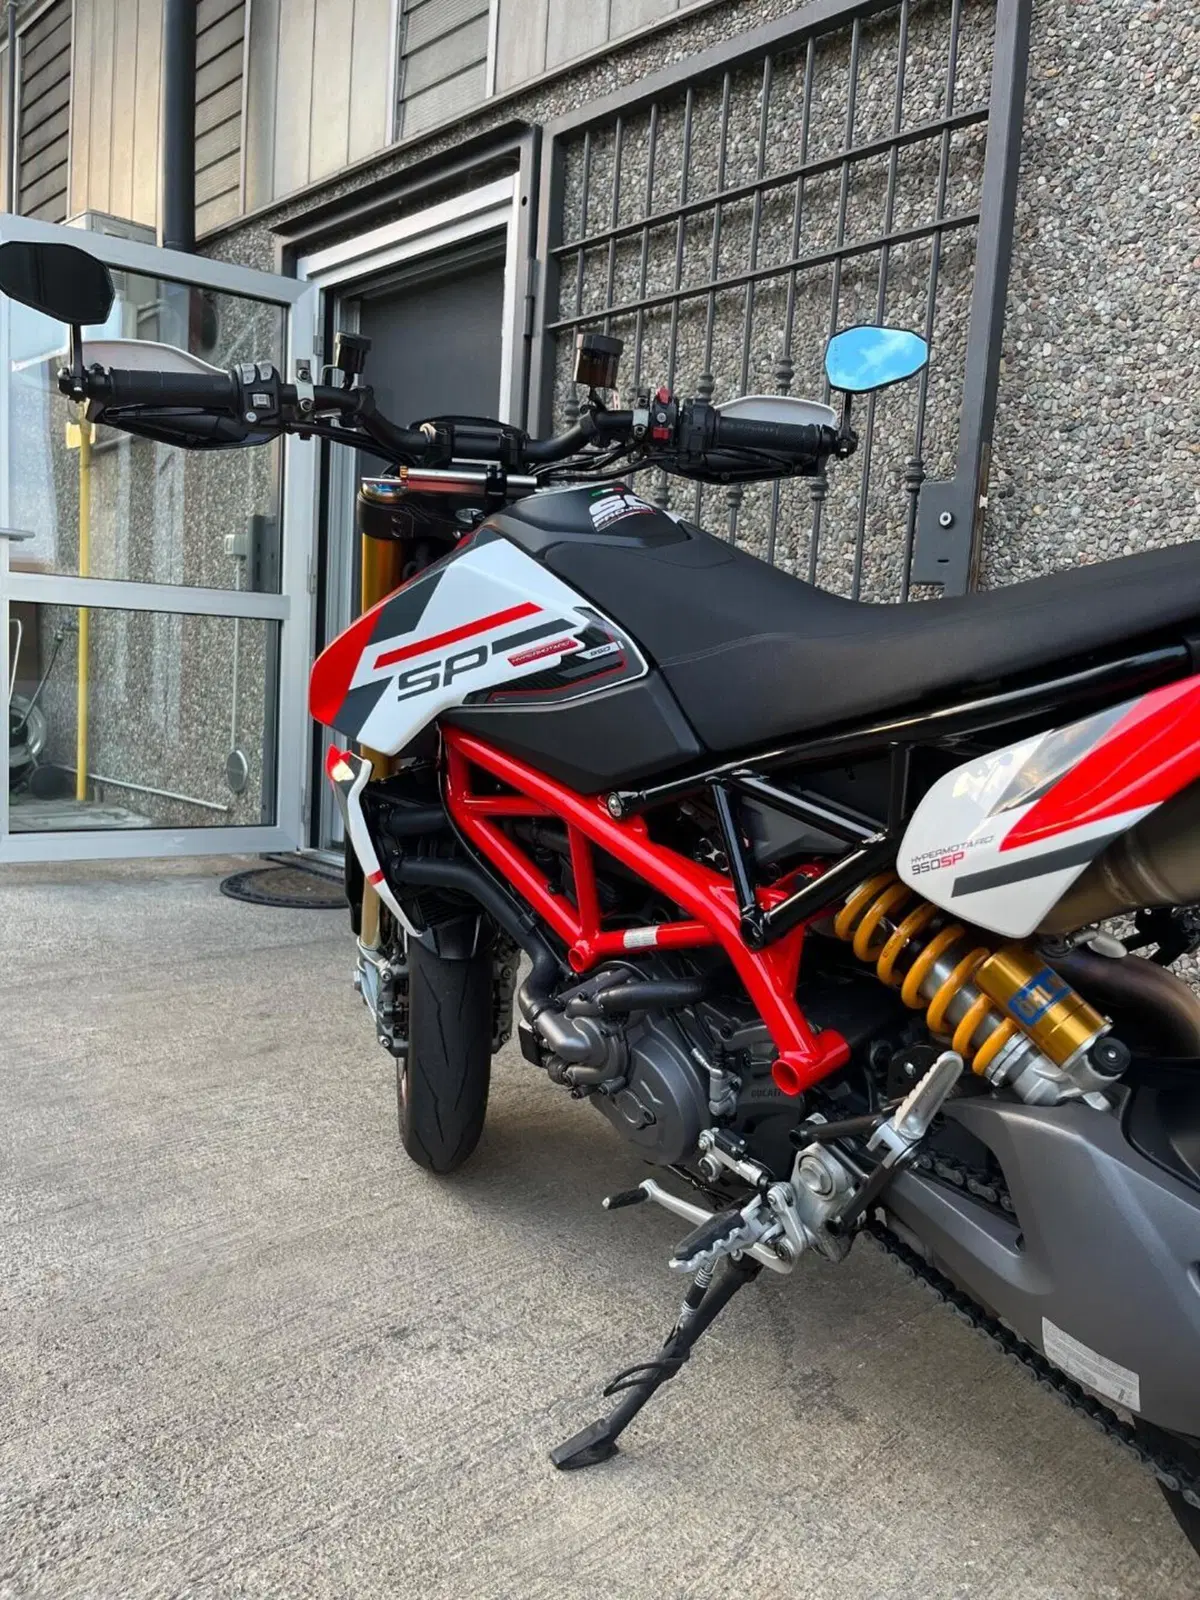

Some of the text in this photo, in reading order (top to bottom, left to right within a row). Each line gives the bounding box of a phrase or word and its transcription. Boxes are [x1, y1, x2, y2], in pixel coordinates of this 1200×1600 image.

[397, 645, 488, 702] SP
[911, 835, 995, 863] HYPERMOTARD
[912, 851, 965, 875] 950SP
